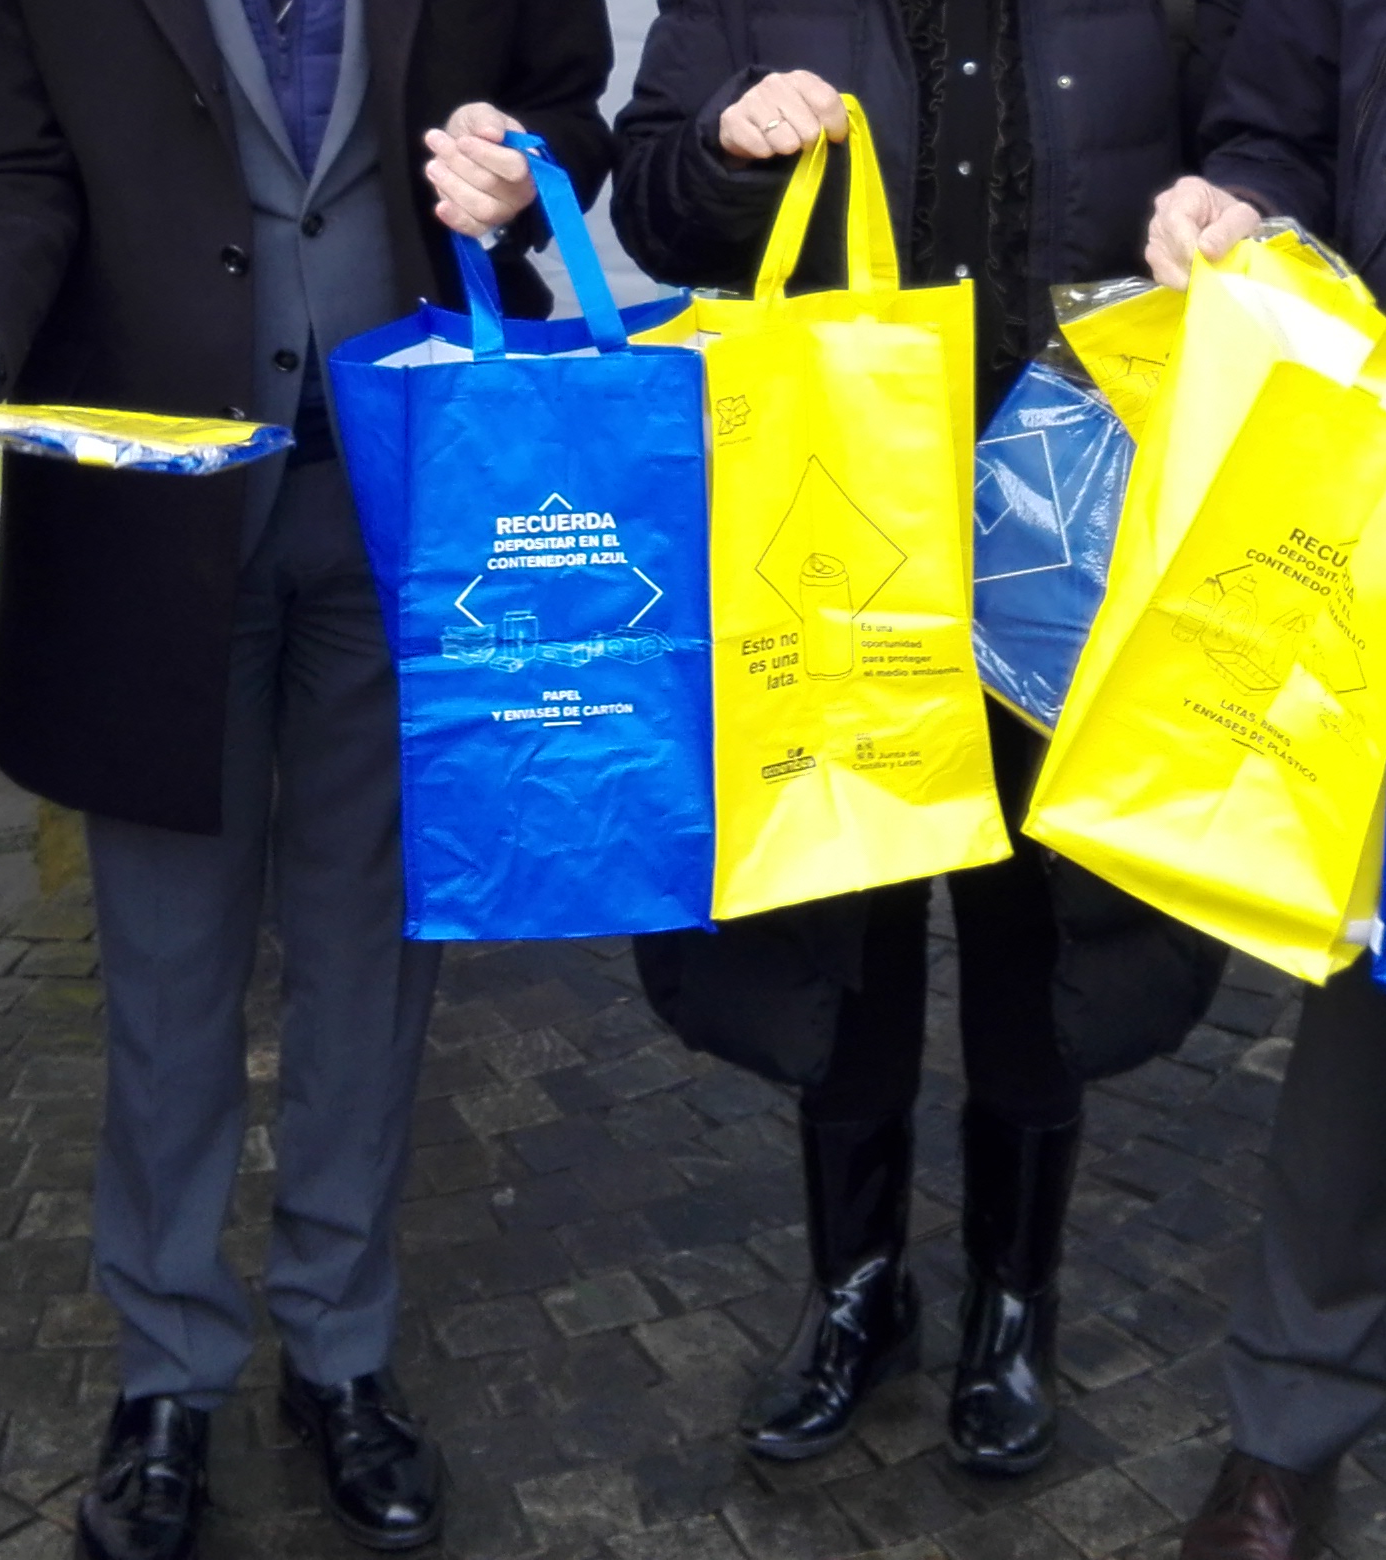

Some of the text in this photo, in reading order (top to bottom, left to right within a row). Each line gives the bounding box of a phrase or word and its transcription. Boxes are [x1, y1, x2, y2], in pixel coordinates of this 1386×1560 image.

[496, 513, 616, 535] RECUERDA
[493, 534, 620, 553] DEPOSITAR EN EL
[487, 552, 628, 570] CONTENEDOR AZUL
[1246, 548, 1331, 597] CONTENEDO
[876, 624, 893, 632] una
[741, 632, 799, 656] Esto no
[861, 640, 922, 650] oportunidad
[749, 651, 799, 674] es una
[862, 655, 931, 664] para proteger
[767, 673, 799, 690] lata.
[543, 690, 582, 702] PAPEL
[491, 702, 633, 721] Y ENVASES DE CARTÓN
[1183, 698, 1317, 782] Y ENVASES DE PLÁSTICO
[1260, 720, 1291, 747] BRIKS
